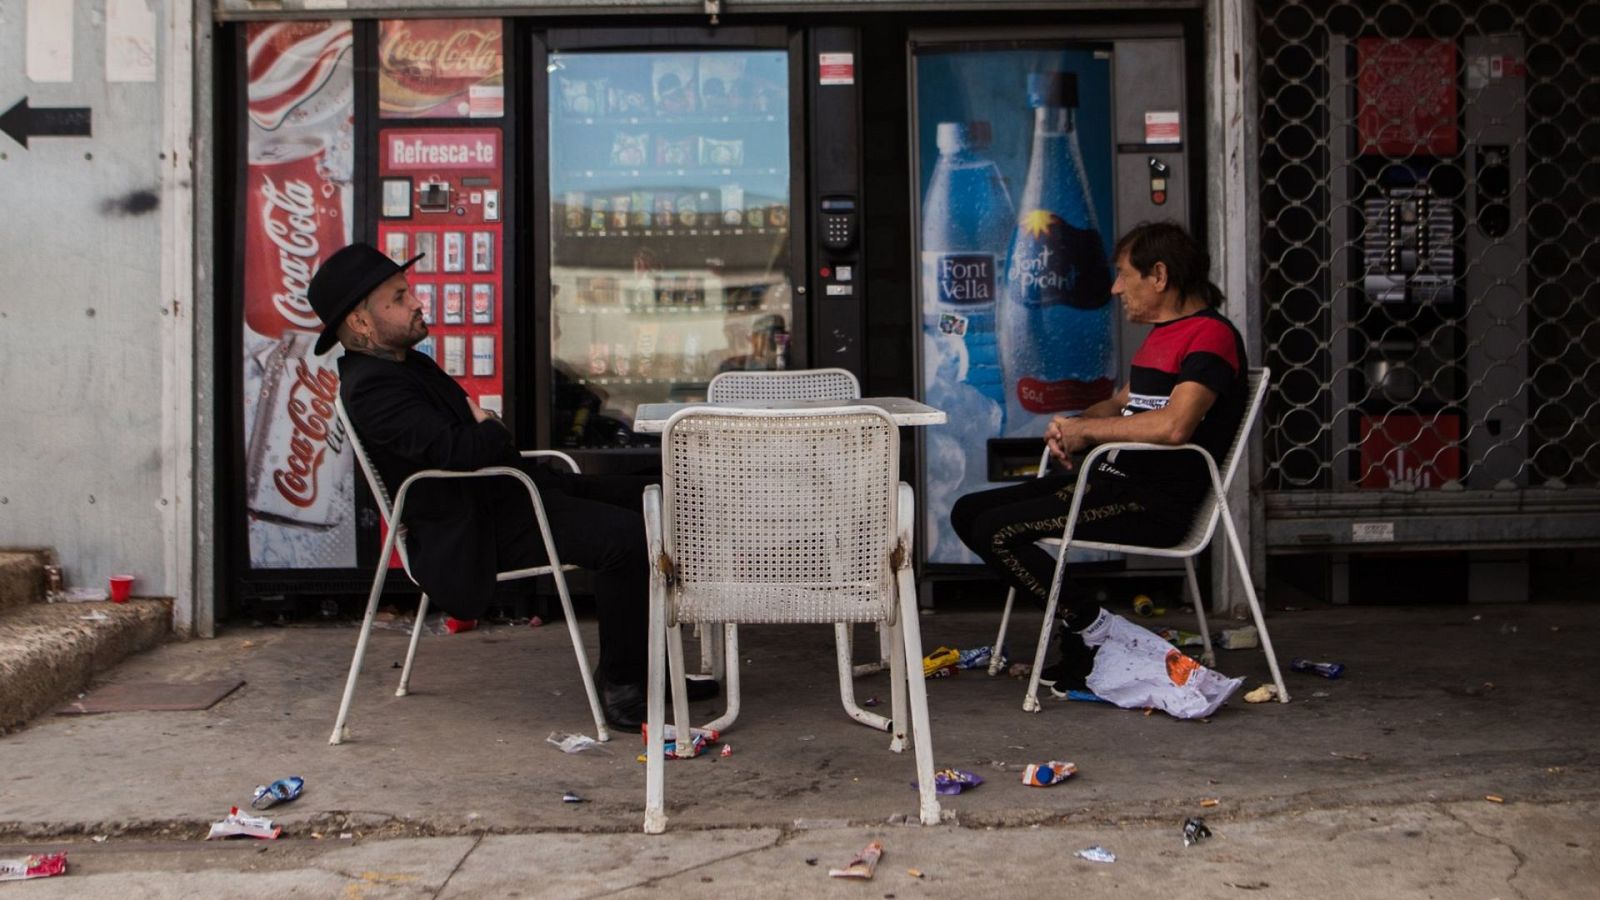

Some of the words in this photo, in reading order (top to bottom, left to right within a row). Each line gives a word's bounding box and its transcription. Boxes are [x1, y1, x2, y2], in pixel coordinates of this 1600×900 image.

[393, 139, 494, 164] Refresca-te
[942, 259, 987, 280] Font
[941, 280, 989, 300] Vella
